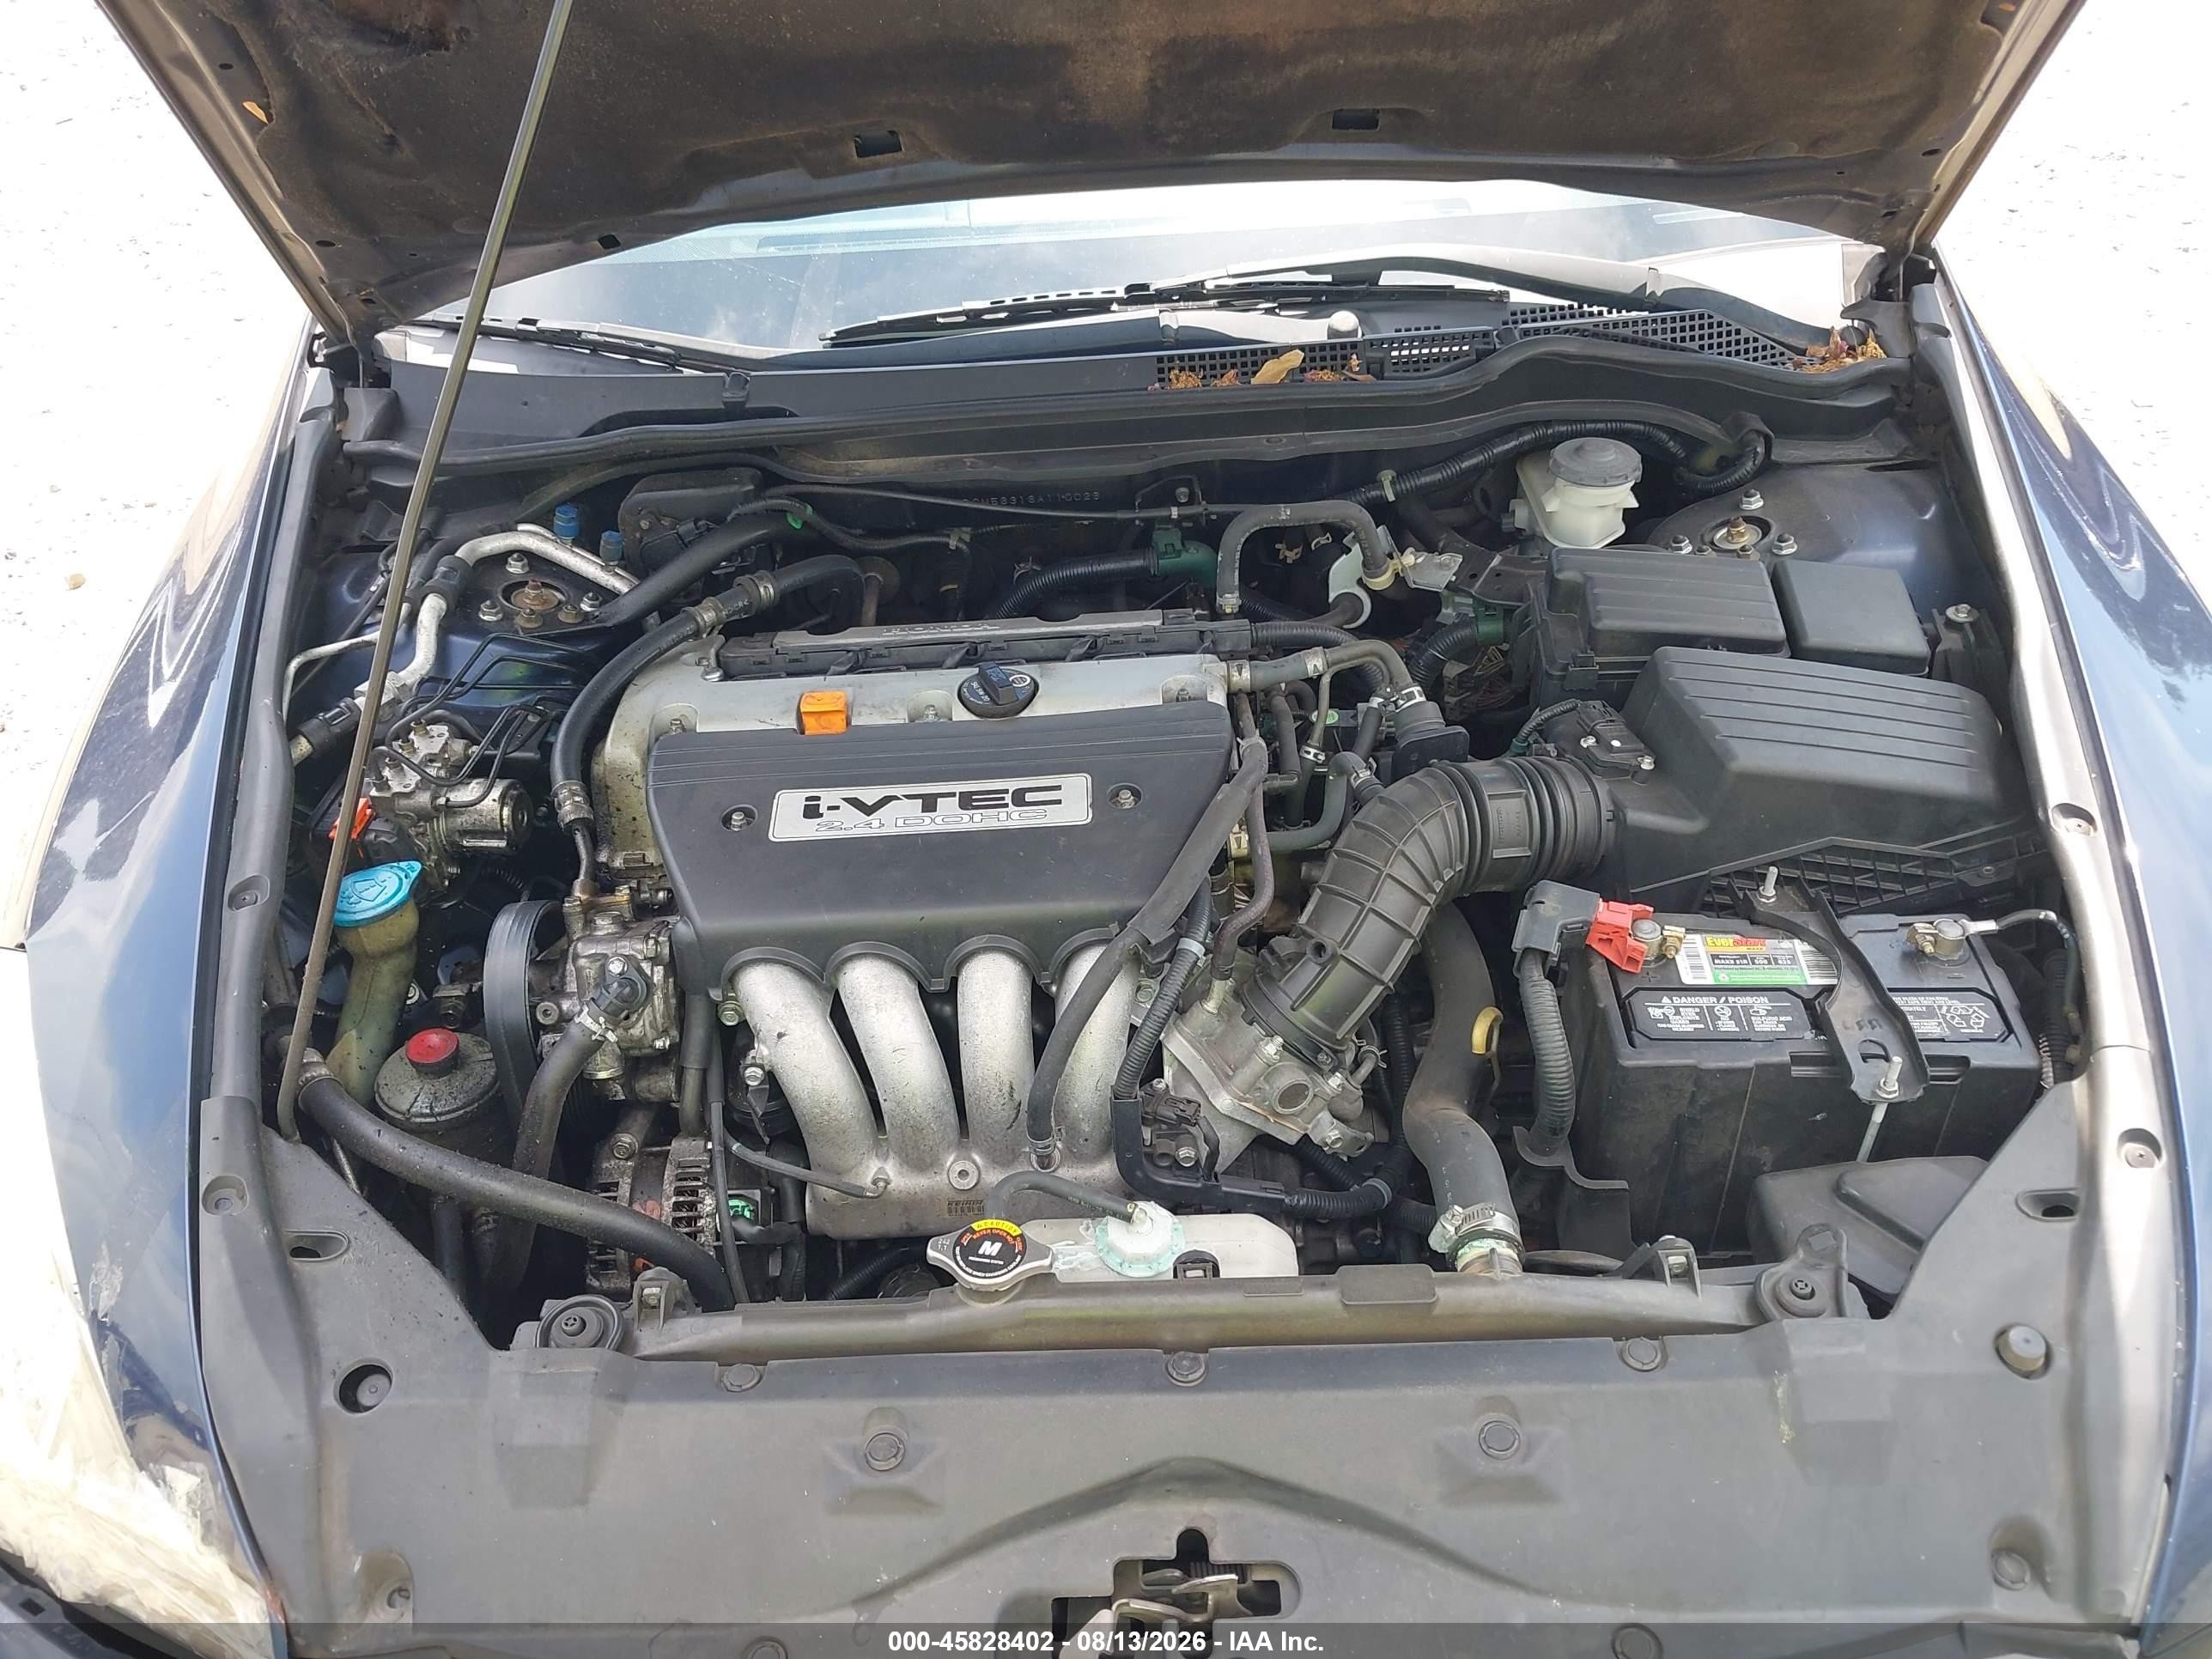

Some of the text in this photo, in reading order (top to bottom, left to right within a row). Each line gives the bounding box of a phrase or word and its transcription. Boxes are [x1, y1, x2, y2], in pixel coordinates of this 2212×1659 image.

[803, 785, 1062, 820] i-VTEC
[815, 808, 1048, 832] 2.4 DOHC
[972, 1229, 991, 1239] NEVER
[984, 1220, 1018, 1234] CAUTION
[978, 1241, 1003, 1256] M
